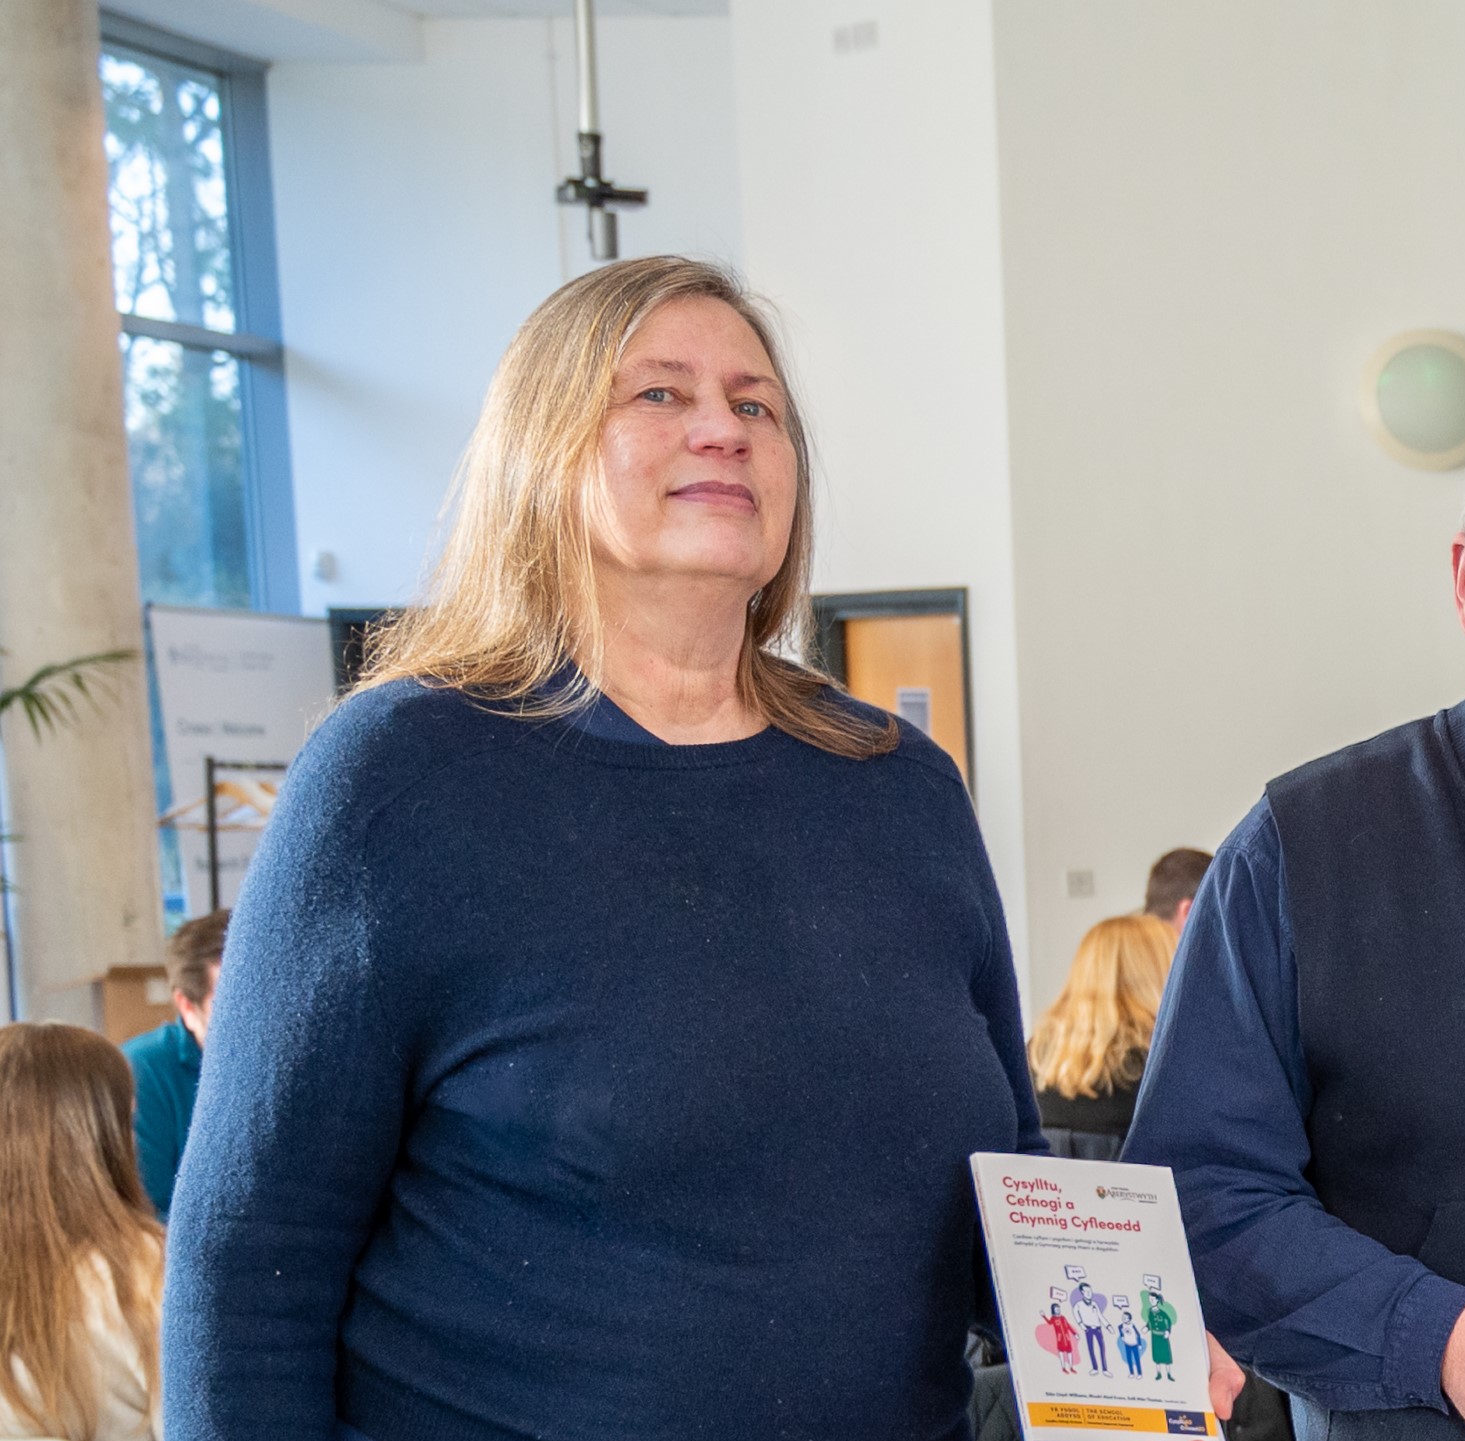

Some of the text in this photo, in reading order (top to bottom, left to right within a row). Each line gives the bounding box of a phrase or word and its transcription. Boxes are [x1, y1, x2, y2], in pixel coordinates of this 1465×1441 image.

[1002, 1176, 1062, 1194] Cysylltu,
[1006, 1194, 1075, 1212] Cefnogi a
[1009, 1212, 1141, 1232] Chynnig Cyfleoedd
